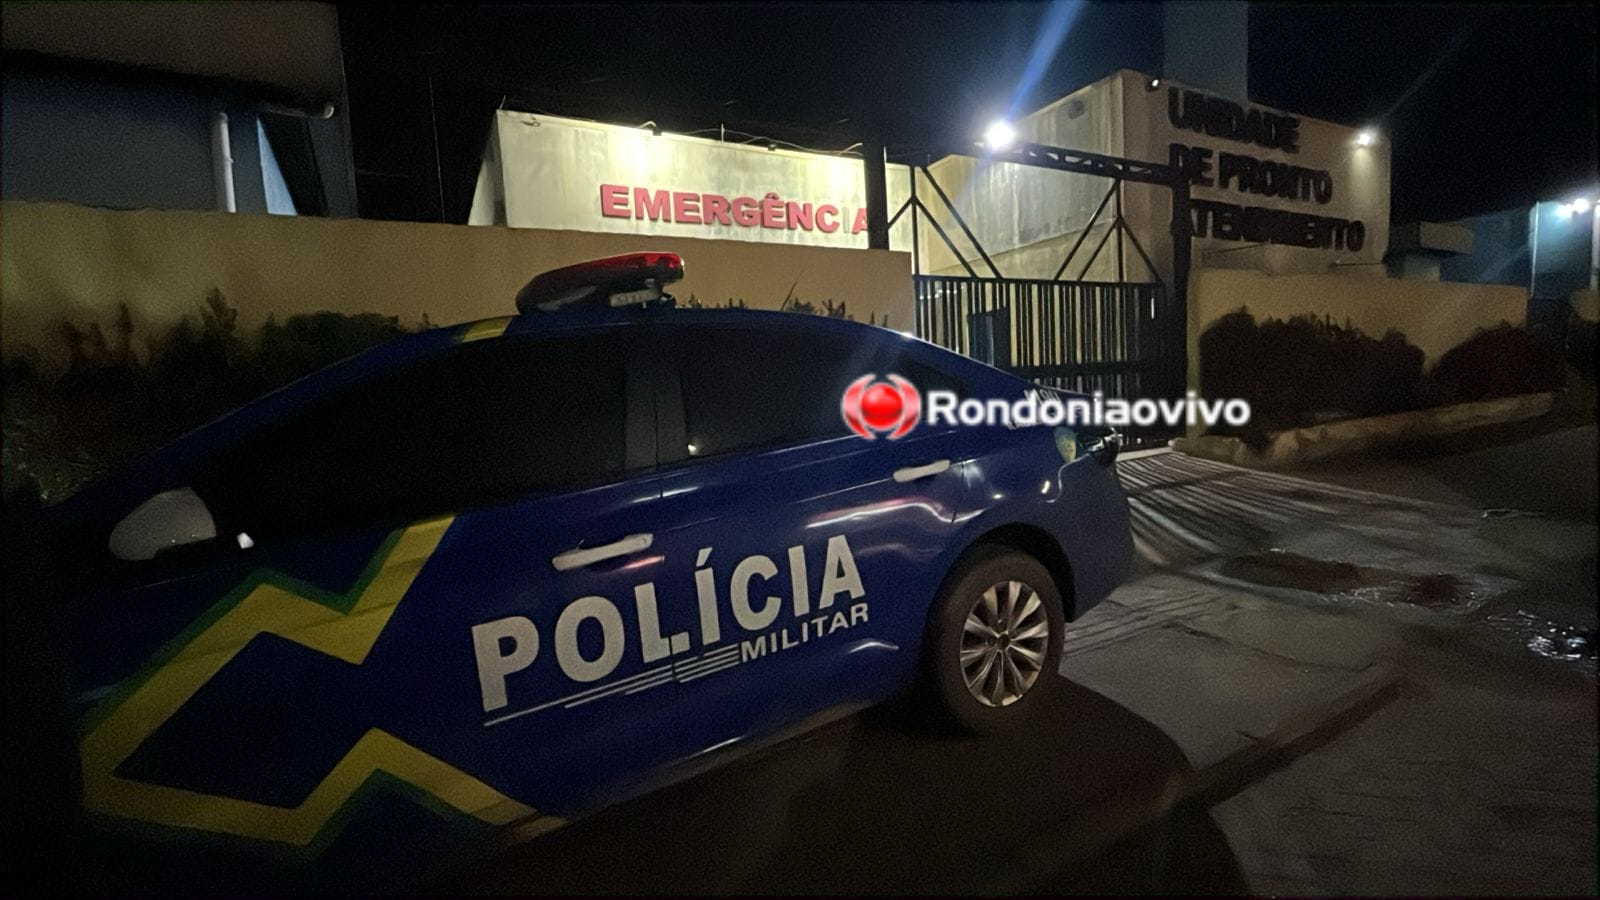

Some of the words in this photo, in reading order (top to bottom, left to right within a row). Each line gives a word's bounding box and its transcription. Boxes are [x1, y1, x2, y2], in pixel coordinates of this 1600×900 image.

[1168, 86, 1300, 153] UNIDADE
[1168, 143, 1213, 186] DE
[1219, 151, 1332, 204] PRONTO
[1189, 198, 1365, 252] TENDIMENTO
[471, 534, 867, 712] POLÍCIA
[740, 602, 869, 663] MILITAR
